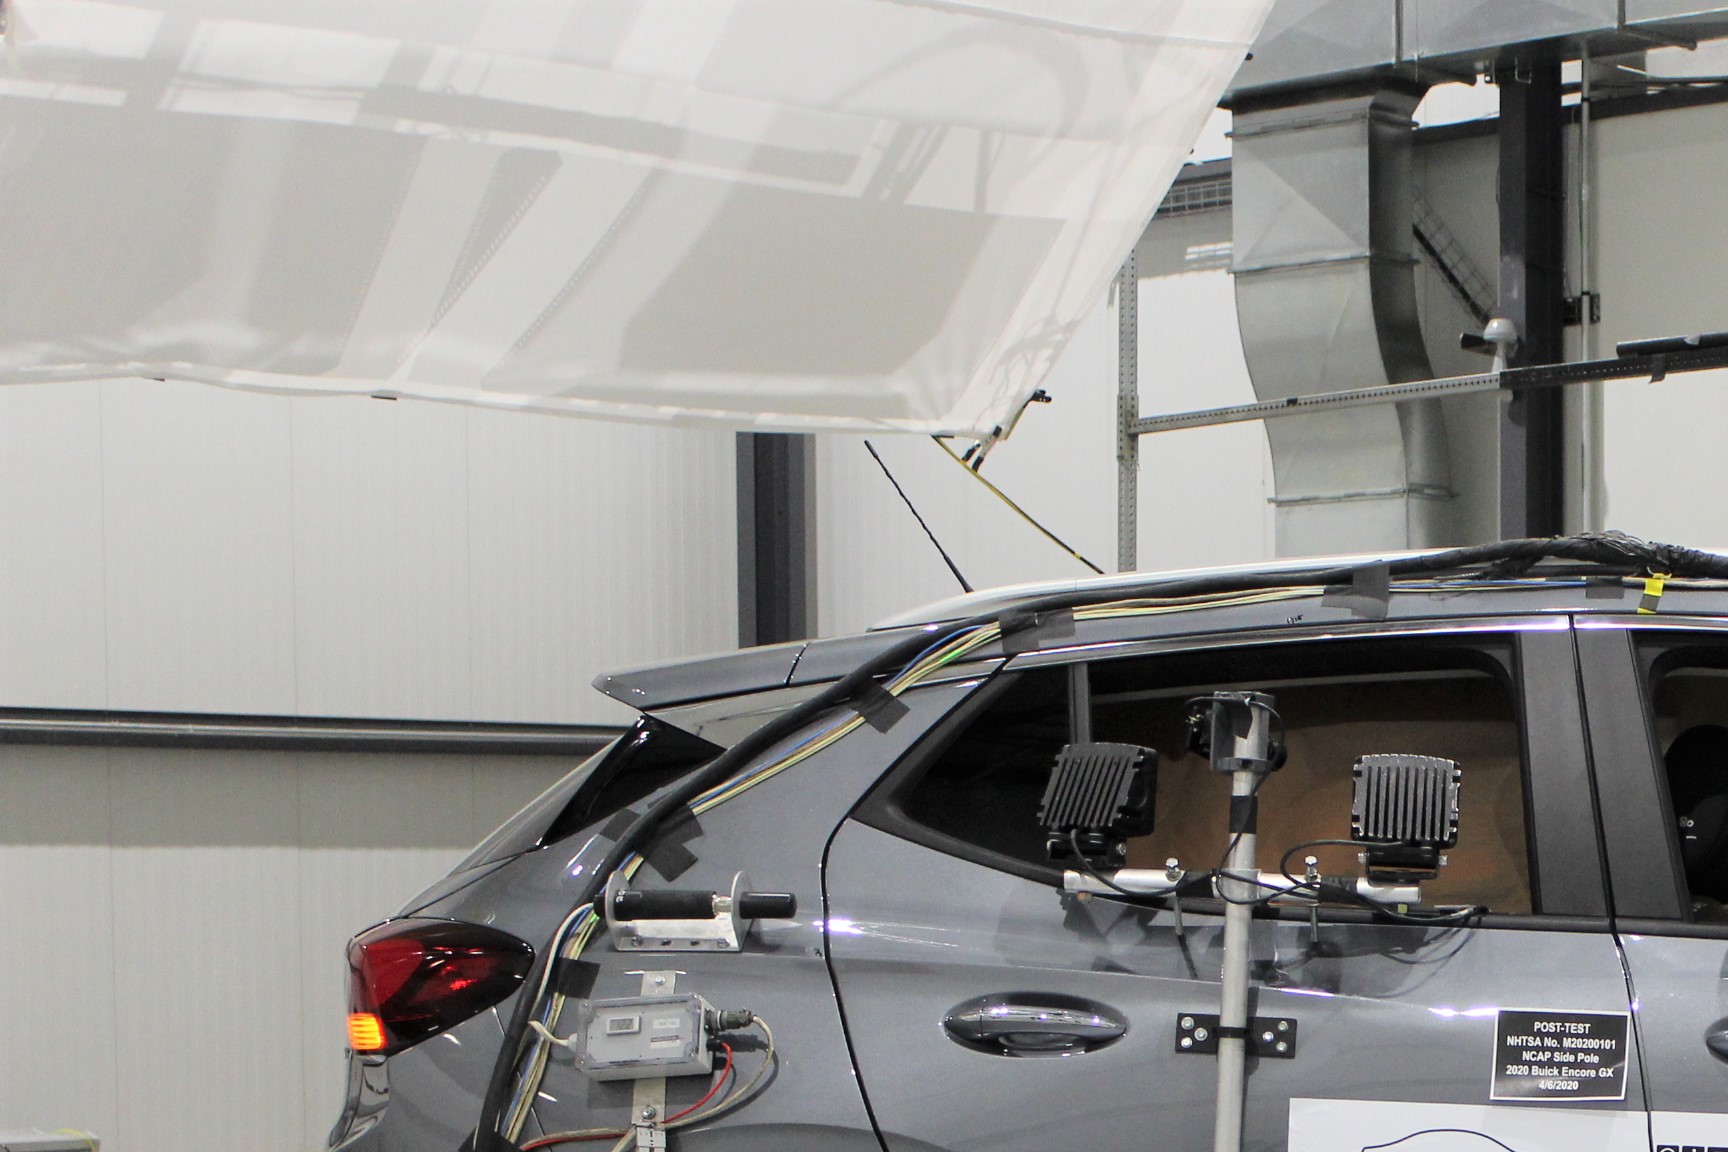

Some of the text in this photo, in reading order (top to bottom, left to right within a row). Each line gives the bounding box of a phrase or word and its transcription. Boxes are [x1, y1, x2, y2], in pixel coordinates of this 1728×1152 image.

[1534, 1022, 1591, 1034] POST-TEST
[1507, 1036, 1616, 1049] NHTSA No. M20200101
[1522, 1051, 1599, 1063] NCAP Side Pole
[1506, 1065, 1614, 1078] 2020 Buick Encore GX
[1539, 1081, 1579, 1090] 4/6/2020
